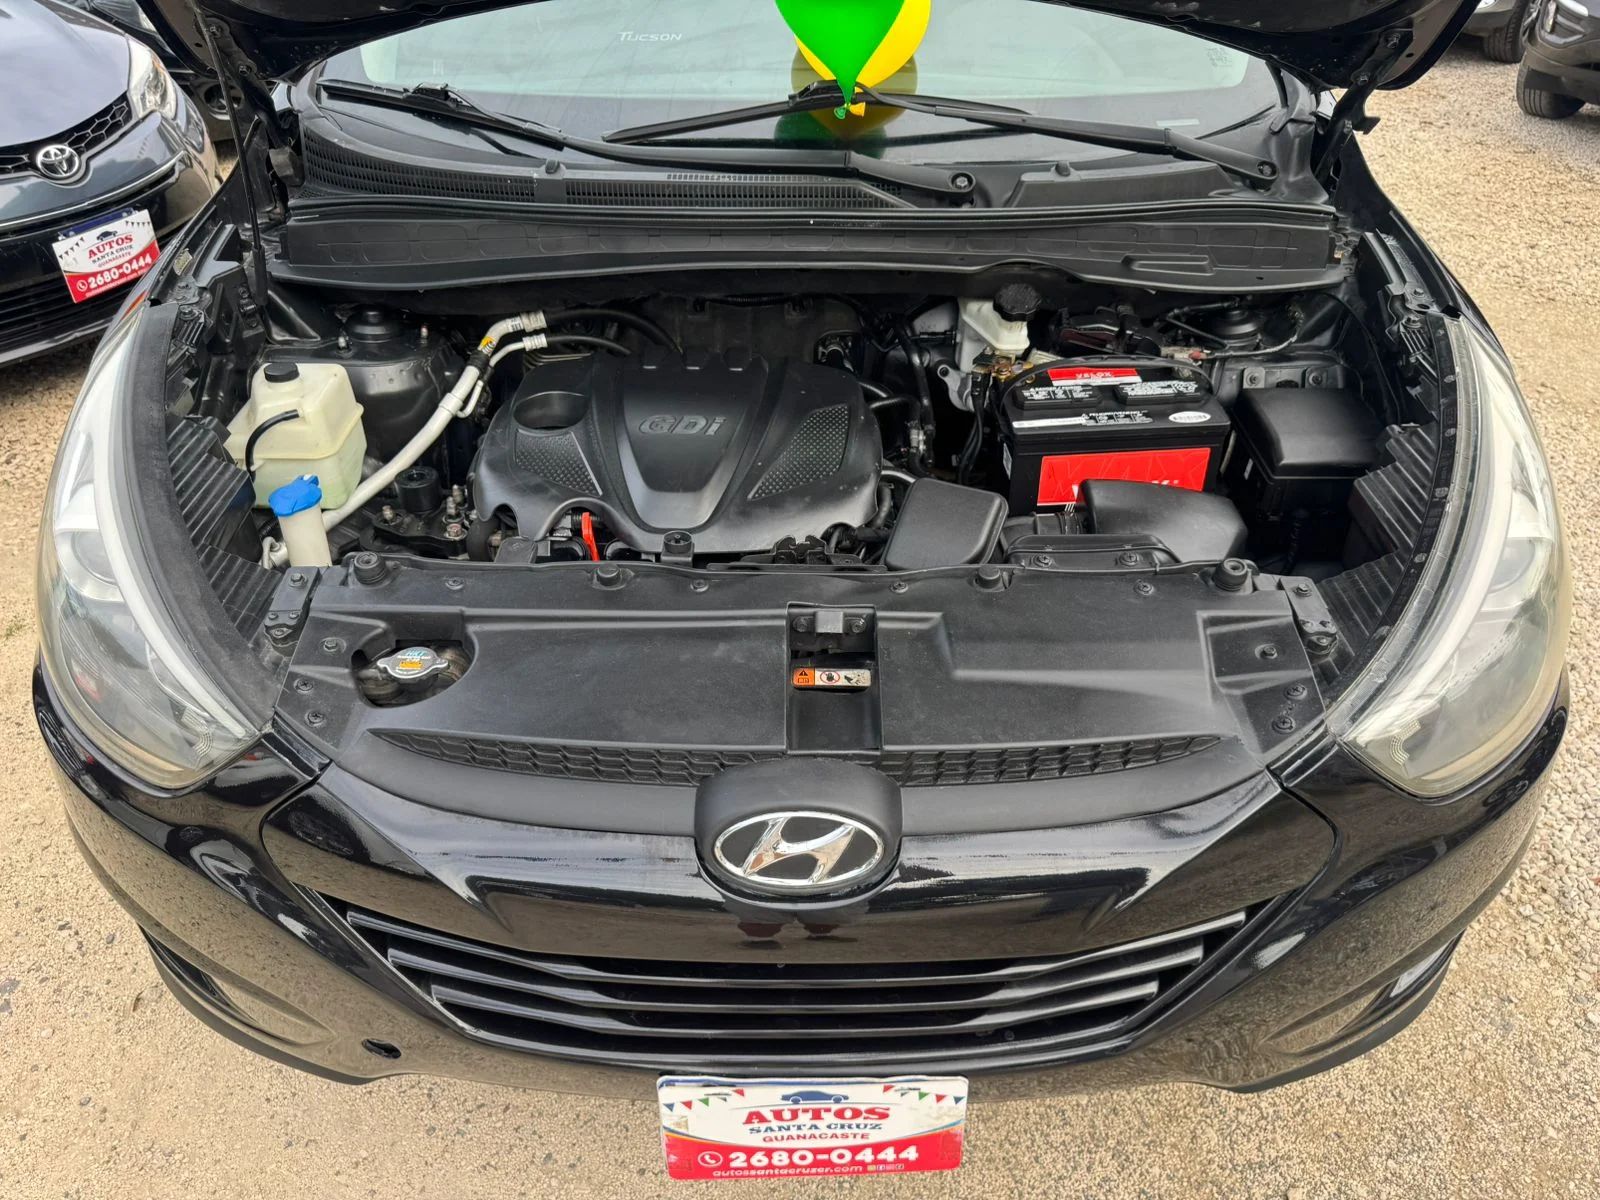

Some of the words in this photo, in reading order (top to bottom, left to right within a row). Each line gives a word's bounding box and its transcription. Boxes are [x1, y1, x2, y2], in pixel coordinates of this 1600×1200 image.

[88, 234, 133, 259] AUTOS
[87, 253, 152, 289] 2680-0444
[743, 1107, 890, 1125] AUTOS
[749, 1123, 820, 1134] SANTA
[826, 1122, 883, 1130] CRUZ
[762, 1132, 870, 1143] GUANACASTE
[728, 1145, 919, 1168] 2680-0444
